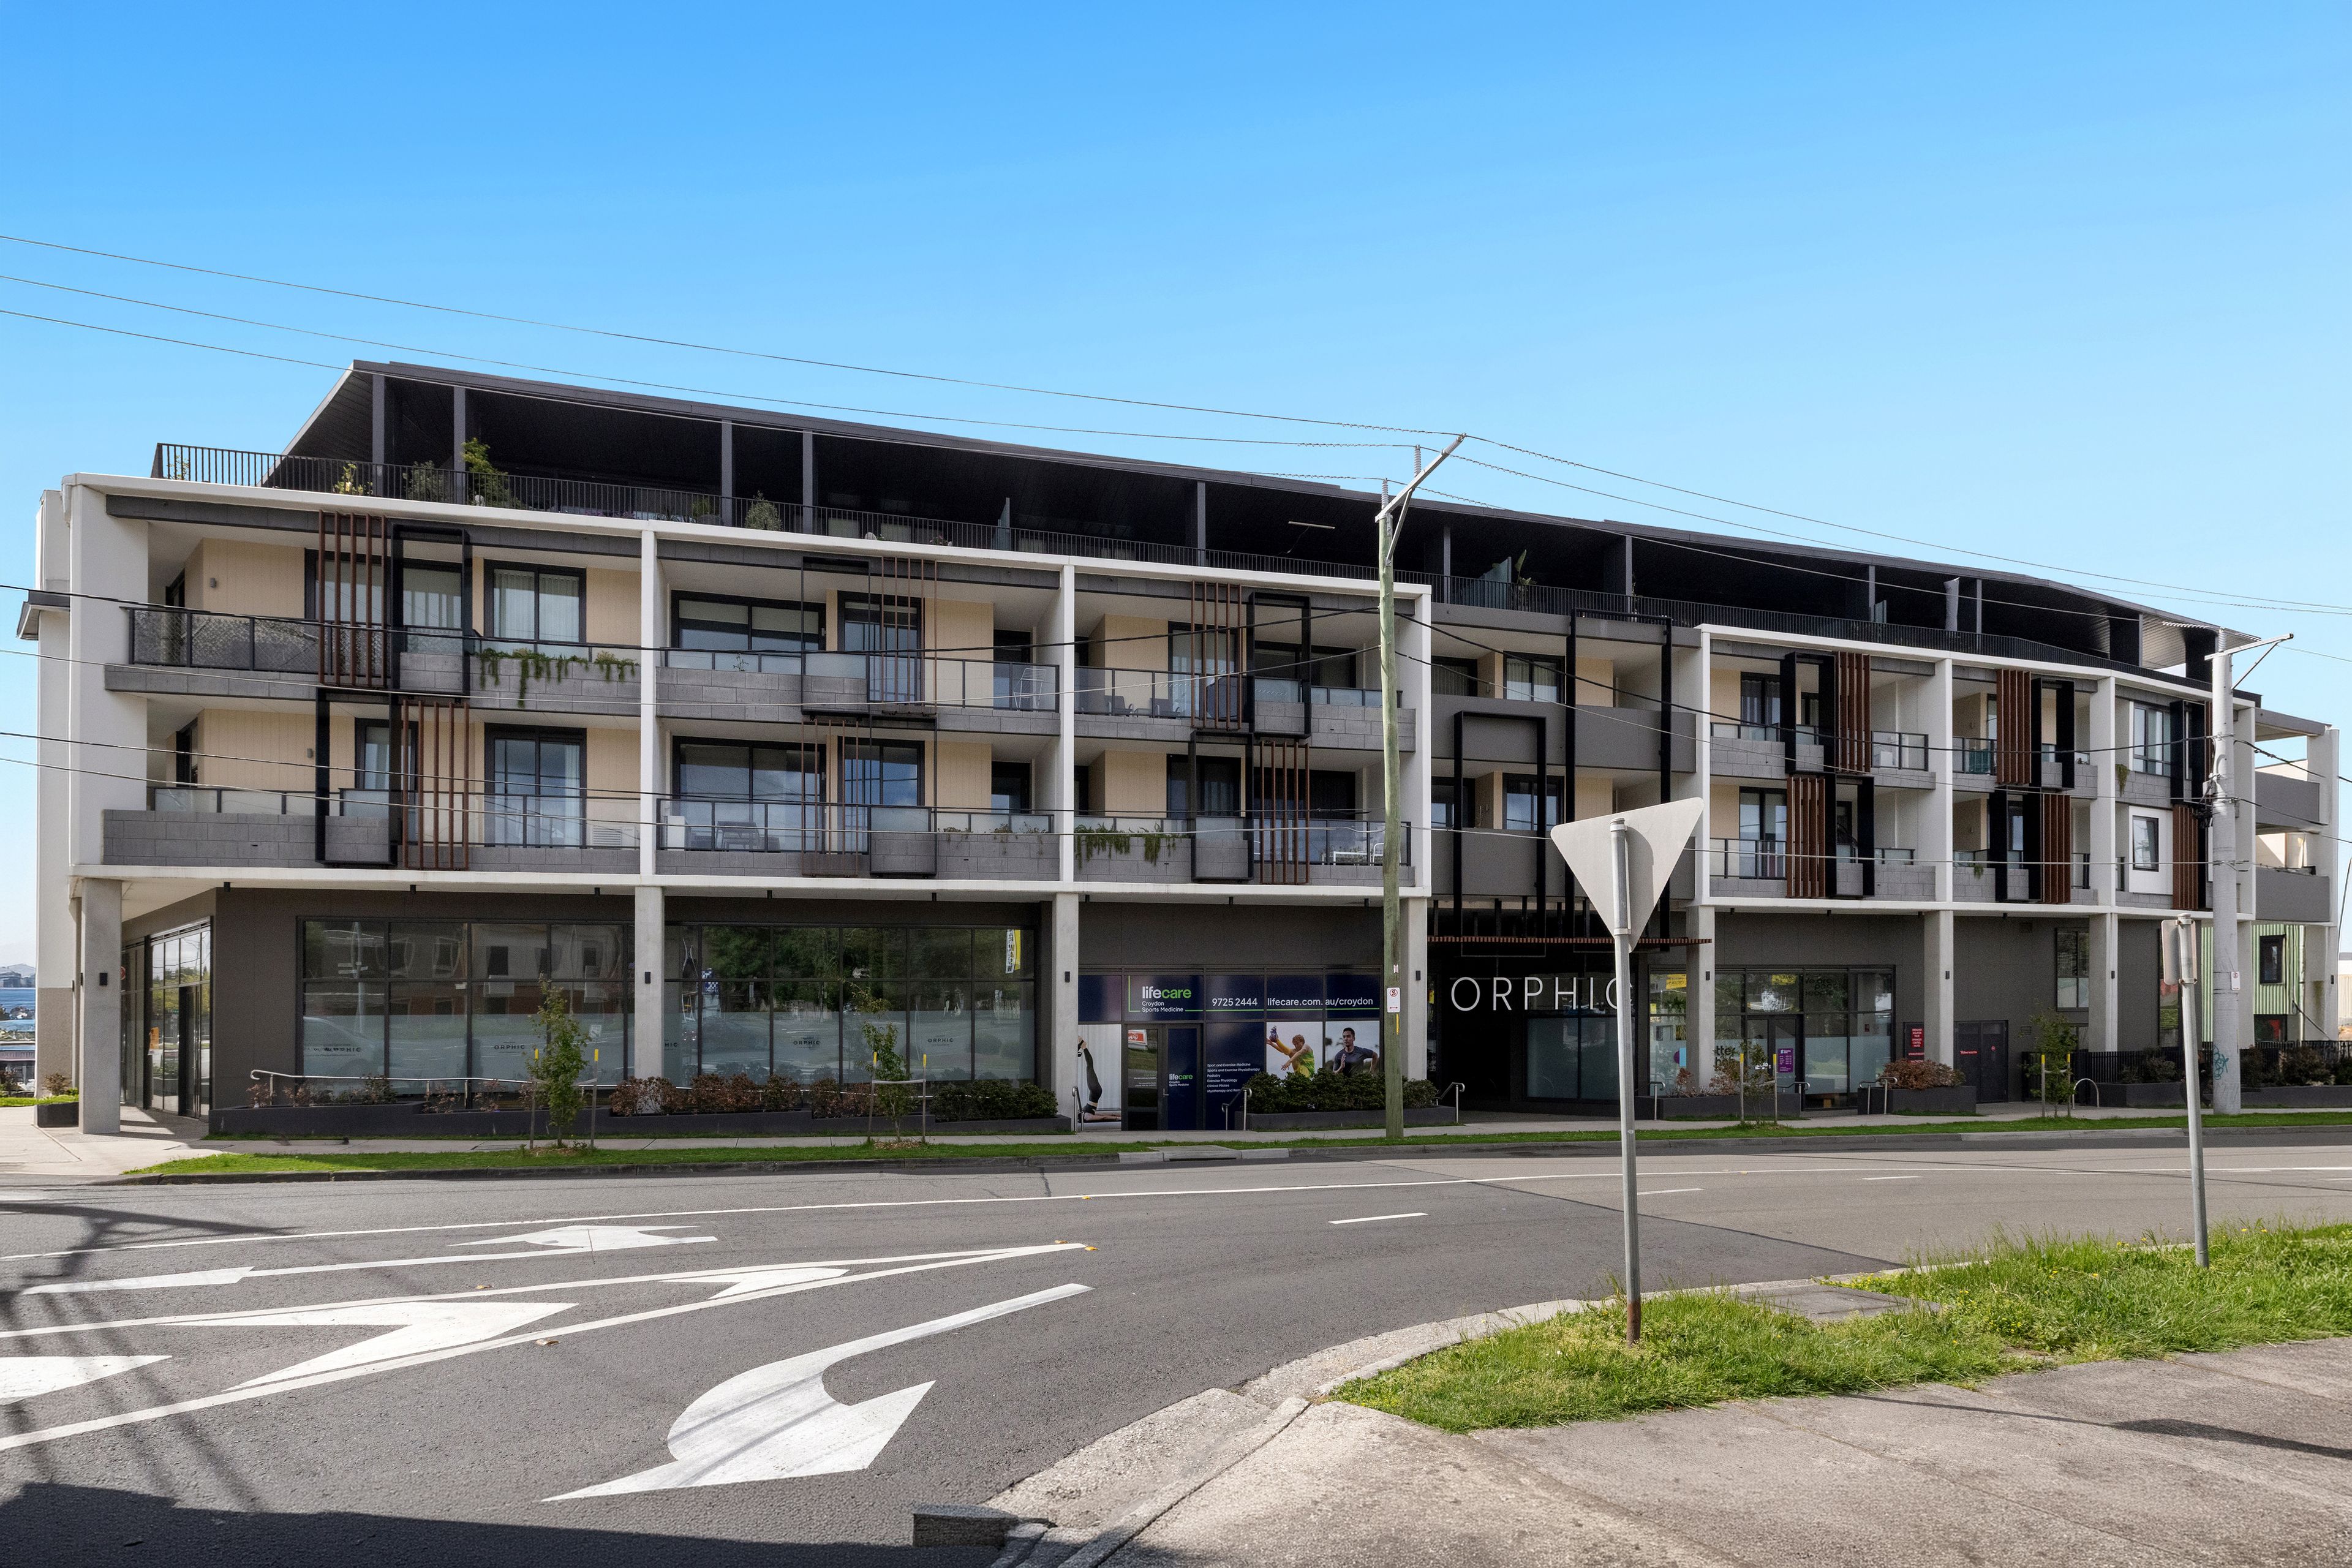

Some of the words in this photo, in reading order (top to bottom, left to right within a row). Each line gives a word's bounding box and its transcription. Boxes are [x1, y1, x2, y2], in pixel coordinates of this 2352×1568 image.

[1142, 986, 1192, 999] lifecare
[1212, 998, 1234, 1006] 9725
[1235, 997, 1258, 1006] 2444
